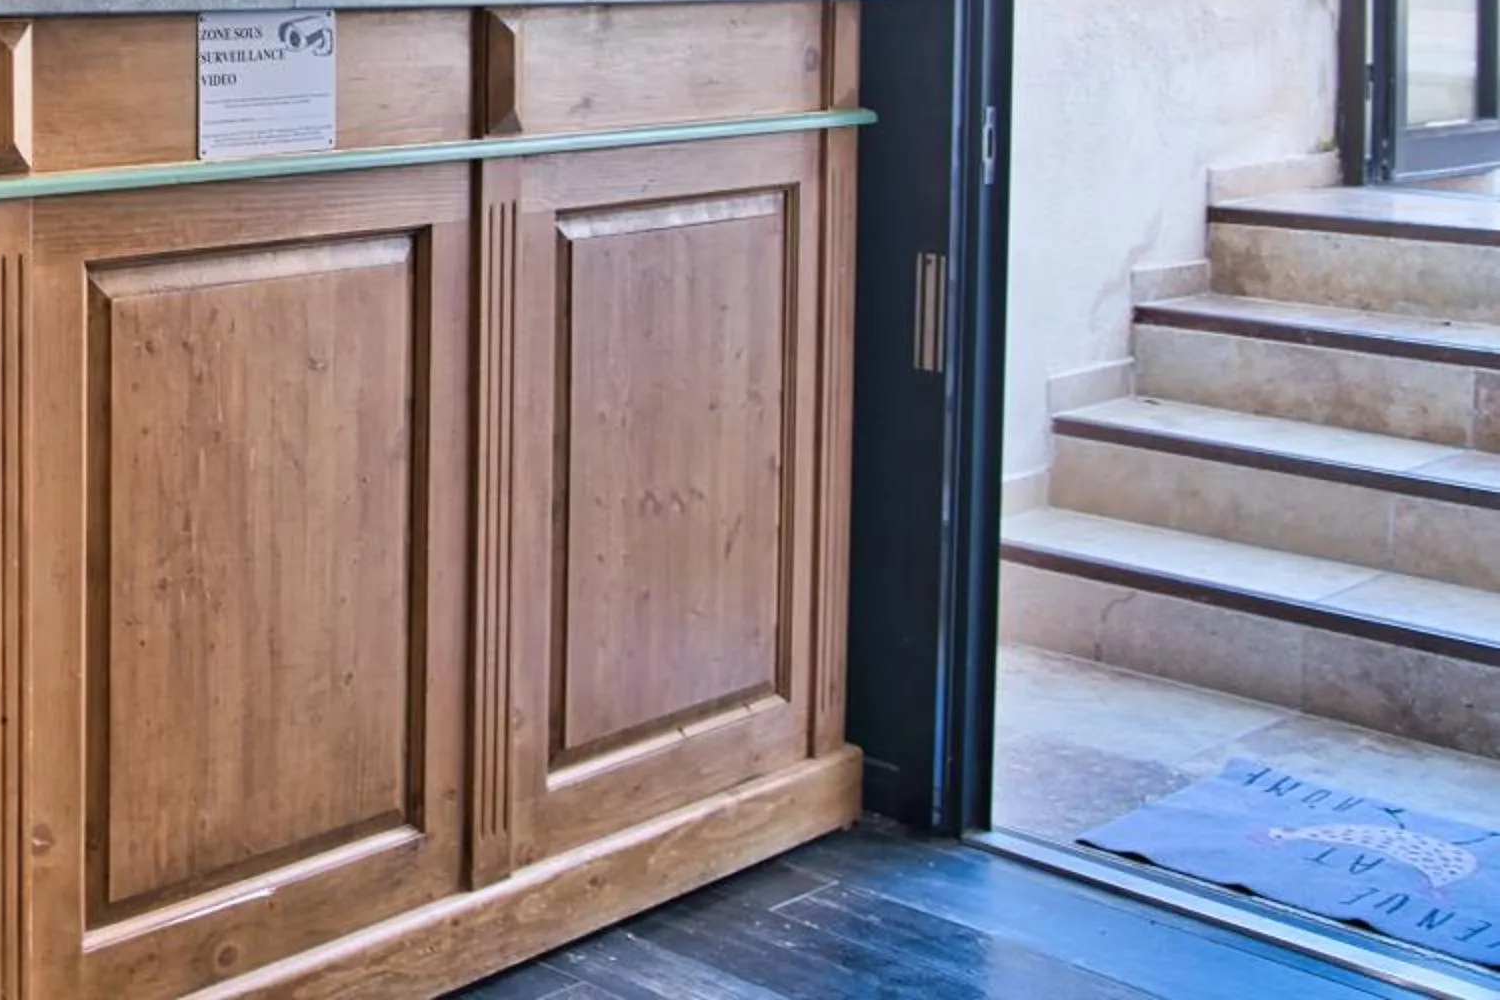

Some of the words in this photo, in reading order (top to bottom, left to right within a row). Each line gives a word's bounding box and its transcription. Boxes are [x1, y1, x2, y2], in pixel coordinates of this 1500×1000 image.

[200, 29, 231, 41] ZONE
[233, 27, 263, 39] SOUS
[200, 49, 285, 65] SURVEILLANCE
[201, 73, 237, 87] VIDEO
